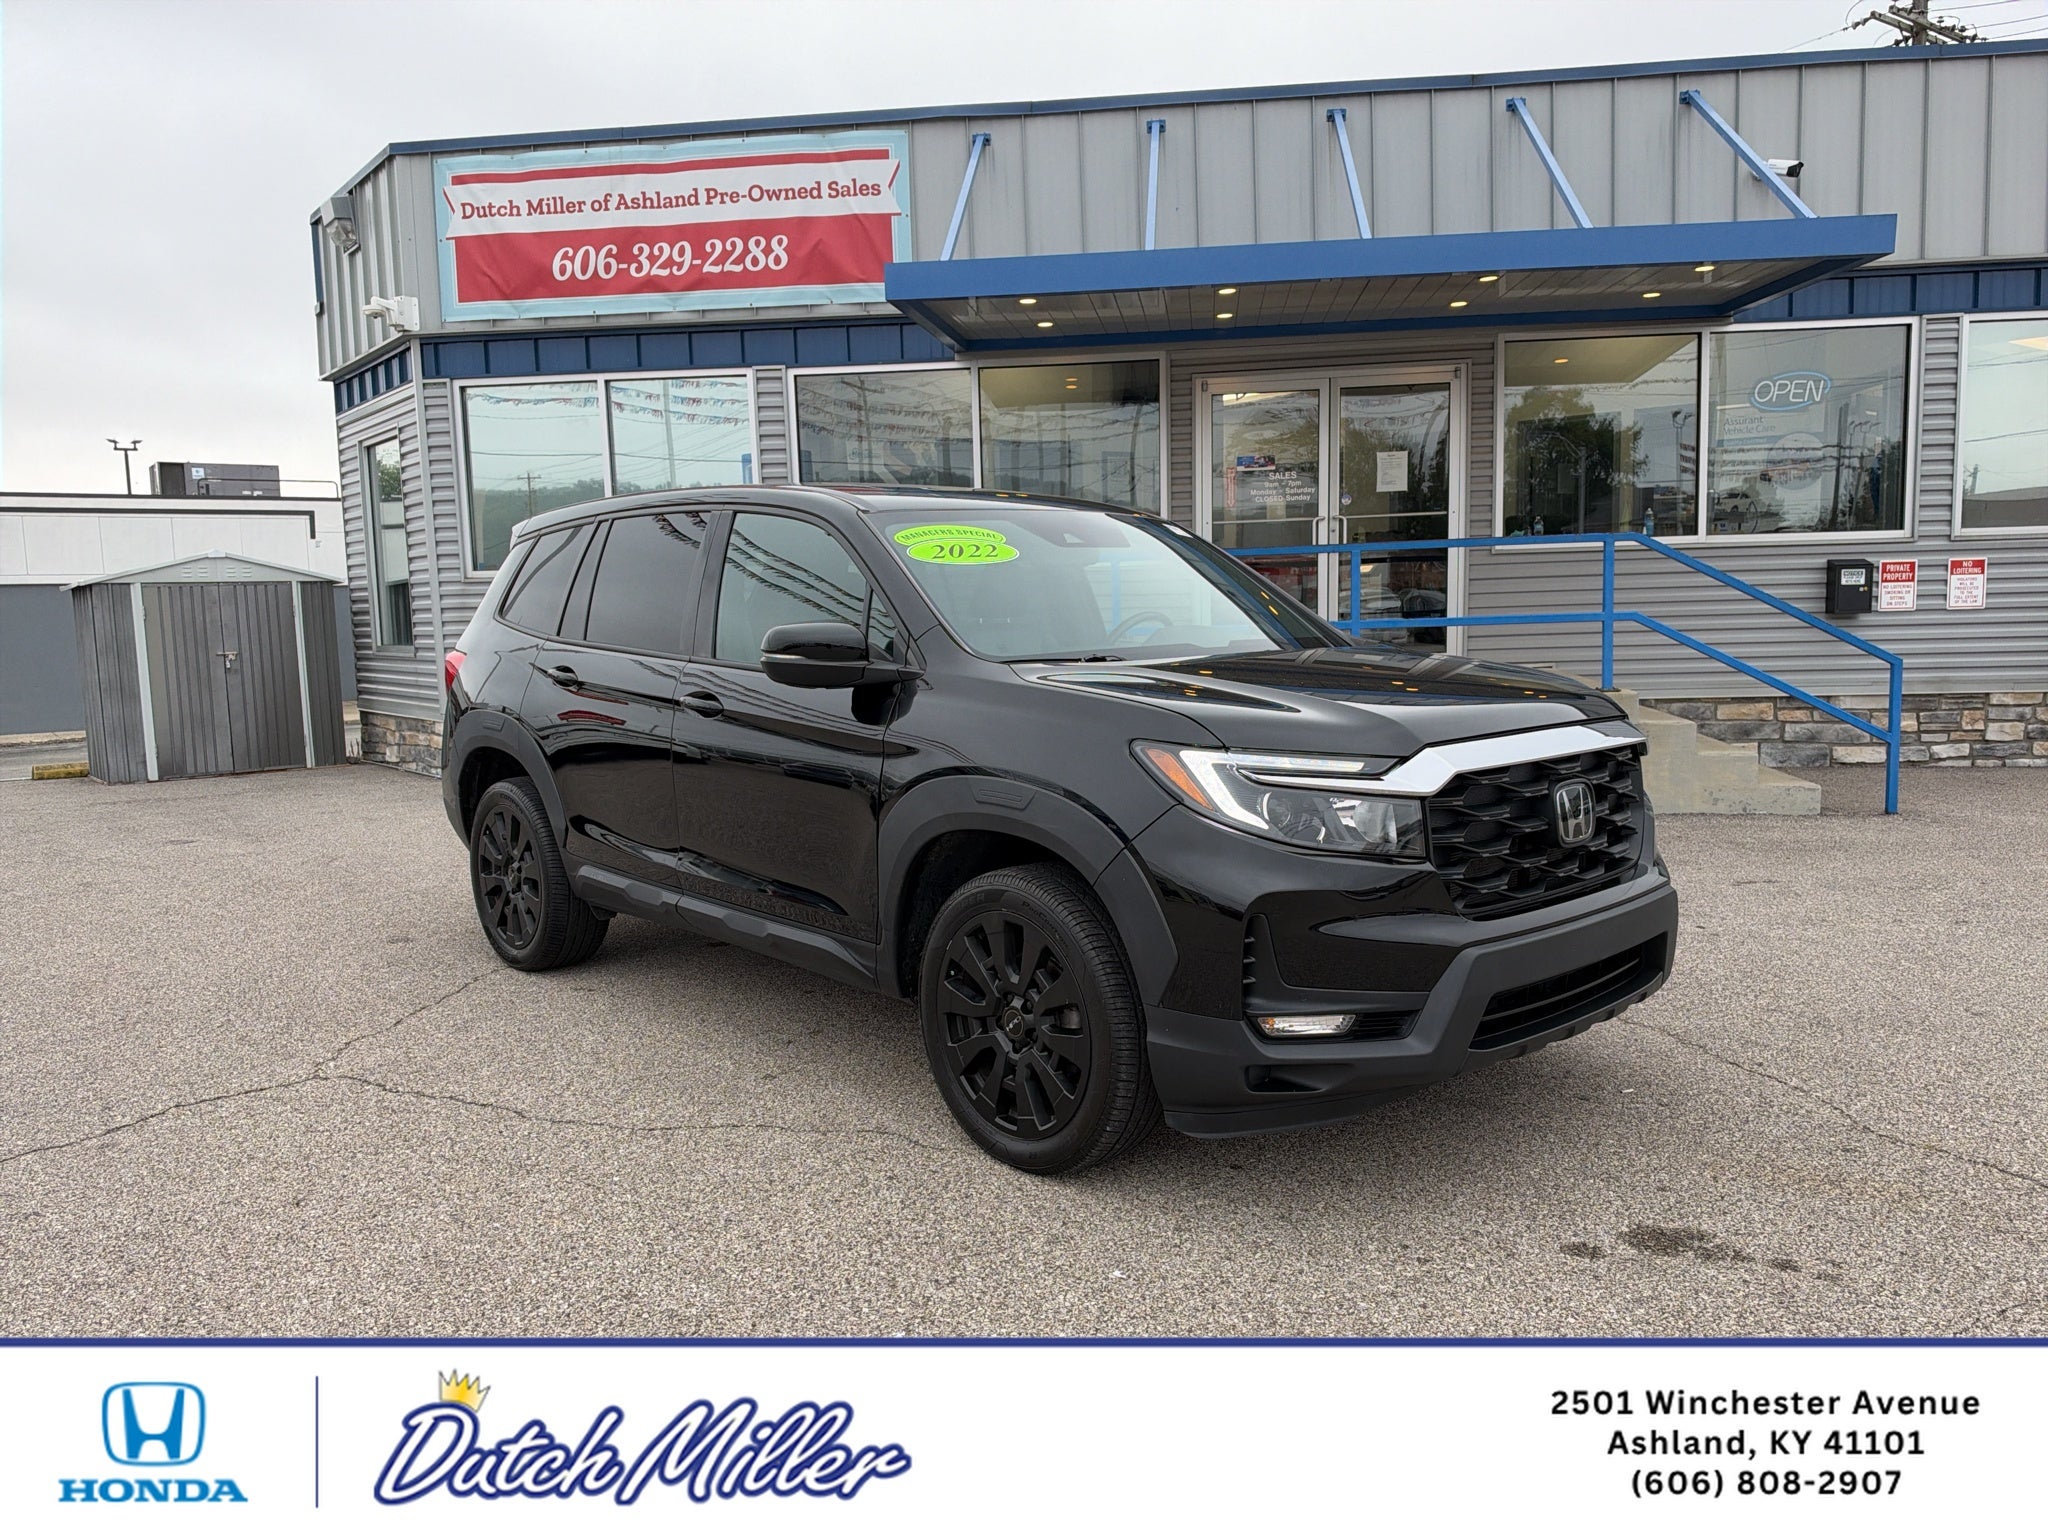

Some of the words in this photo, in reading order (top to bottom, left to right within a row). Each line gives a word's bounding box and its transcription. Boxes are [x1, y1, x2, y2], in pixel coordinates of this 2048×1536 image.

[461, 200, 521, 219] Dutch
[527, 196, 585, 216] Miller
[590, 193, 612, 212] of
[615, 187, 700, 211] Ashland
[704, 180, 823, 206] Pre-Owned
[827, 178, 882, 199] Sales
[552, 235, 789, 281] 606-329-2288
[1754, 380, 1824, 403] OPEN
[1269, 471, 1297, 480] SALES
[1250, 489, 1277, 497] Monday
[1285, 486, 1316, 495] Saturday
[1285, 494, 1311, 503] Sunday
[956, 529, 996, 539] SPECIAL
[931, 543, 999, 559] 2022
[1886, 564, 1911, 572] PRIVATE
[1883, 572, 1913, 581] PROPERTY
